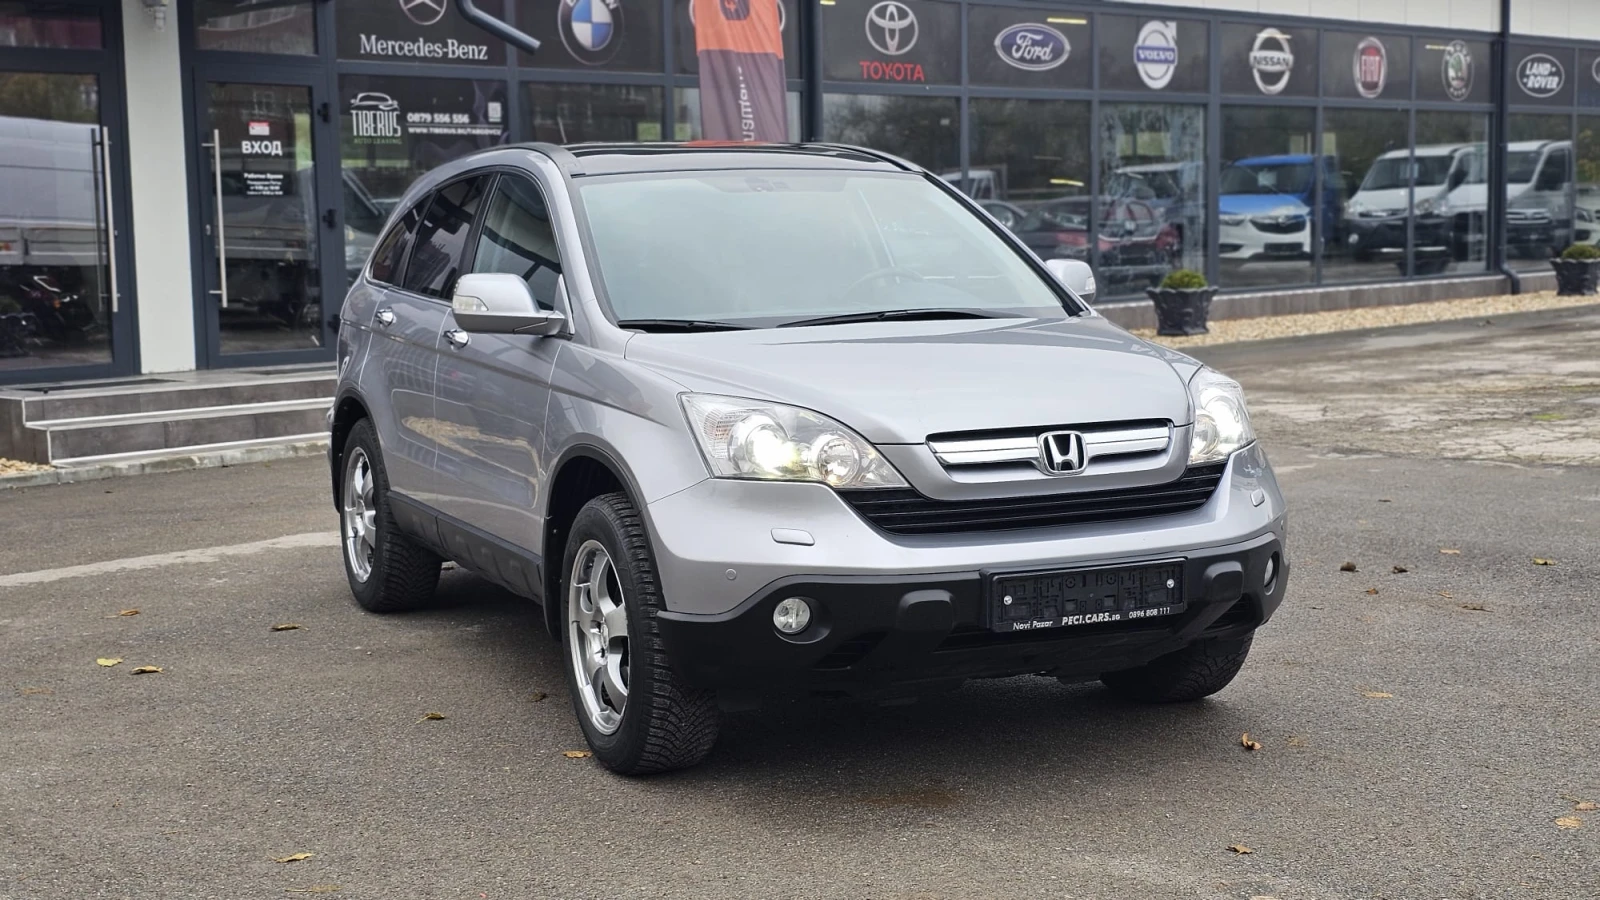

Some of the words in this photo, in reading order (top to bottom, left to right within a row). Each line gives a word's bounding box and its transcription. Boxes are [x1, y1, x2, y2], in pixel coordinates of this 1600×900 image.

[360, 34, 488, 60] Mercedes-Benz
[1011, 31, 1054, 61] Ford
[1138, 49, 1175, 62] VOLVO
[1253, 56, 1291, 68] NISSAN
[859, 61, 925, 81] TOYOTA
[1361, 55, 1380, 82] FIAT
[1525, 62, 1552, 75] LAND
[1526, 75, 1559, 89] ROVER
[350, 110, 402, 137] TIBERUS
[406, 112, 432, 123] 0879
[433, 113, 451, 124] 556
[452, 113, 470, 124] 556
[241, 140, 283, 156] ВХОД
[1012, 621, 1031, 631] Novi
[1032, 620, 1053, 629] Pazar
[1128, 608, 1145, 619] 0896
[1145, 608, 1158, 618] 808
[1159, 606, 1171, 616] 111
